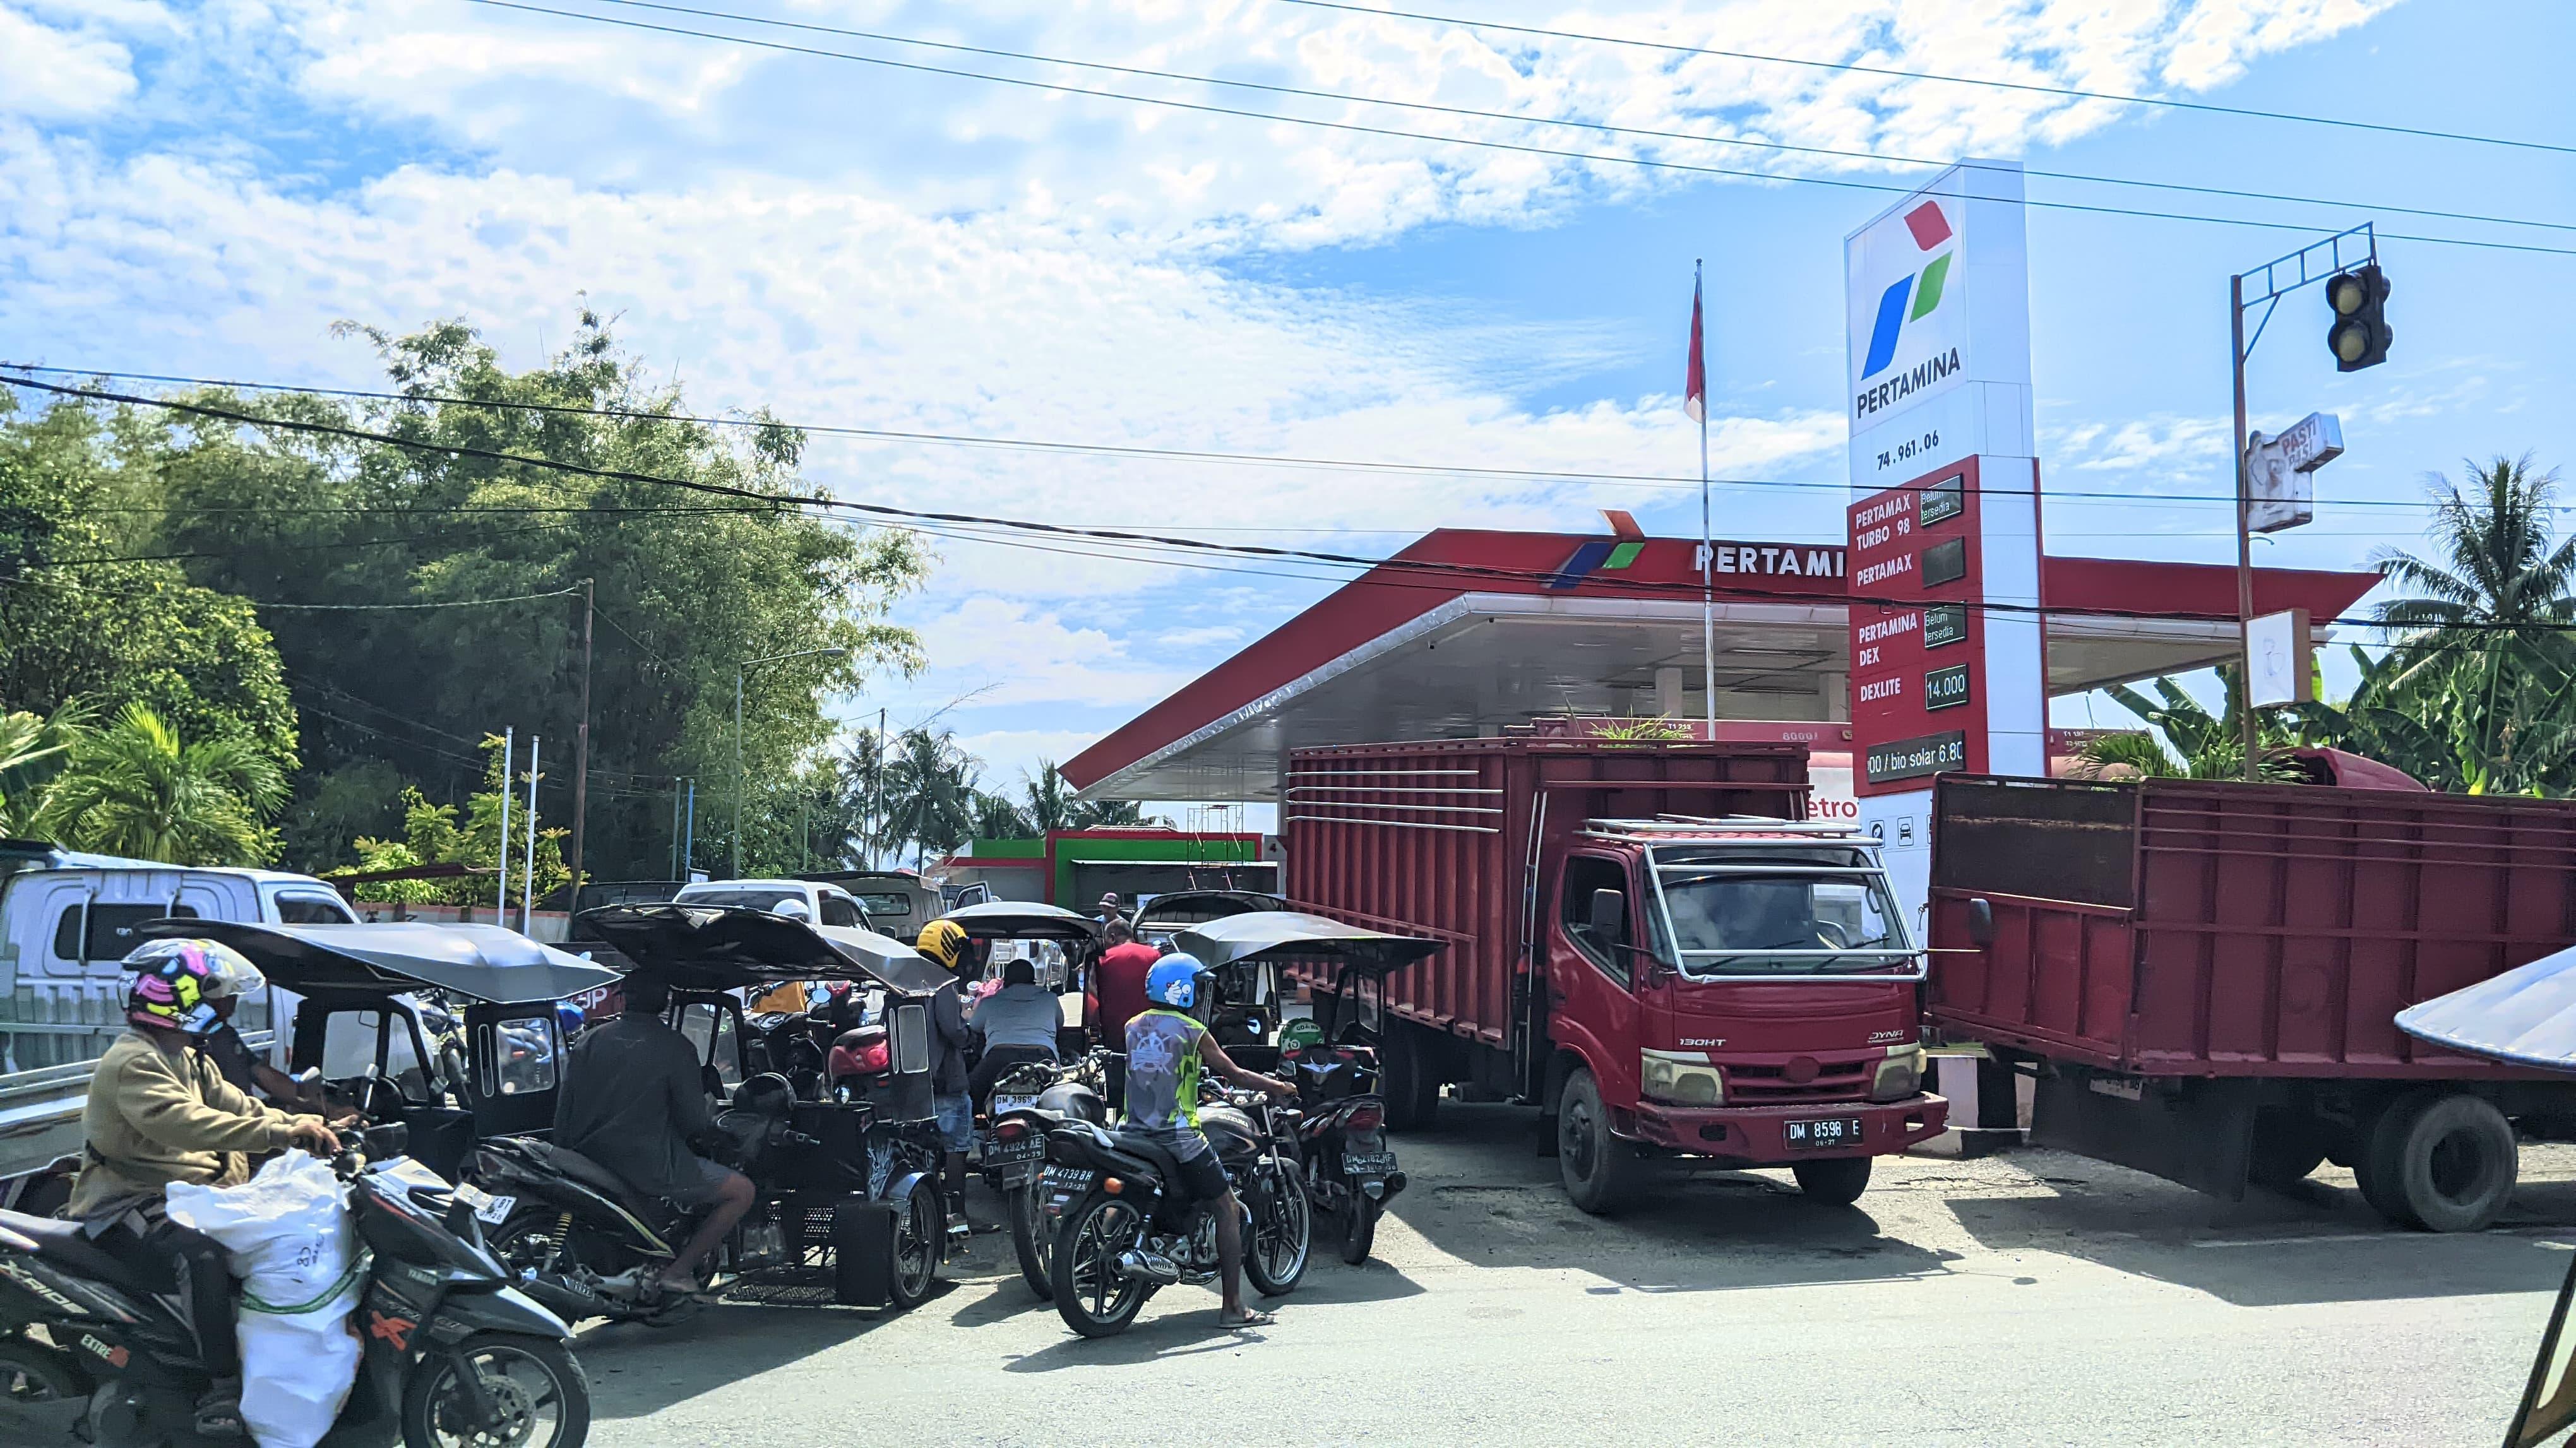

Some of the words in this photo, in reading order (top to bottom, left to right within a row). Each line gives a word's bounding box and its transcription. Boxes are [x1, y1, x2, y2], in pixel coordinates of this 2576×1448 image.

[1857, 347, 1960, 419] PERTAMINA
[2282, 418, 2317, 456] PASTI
[1856, 494, 1911, 529] PERTAMAX
[1921, 502, 1950, 521] tersedia
[1856, 525, 1890, 551] TURBO
[1897, 518, 1910, 536] 98
[1695, 545, 1848, 577] PERTAMI
[1857, 553, 1912, 587] PERTAMAX
[1859, 613, 1917, 644] PERTAMINA
[1925, 613, 1948, 626] Belum
[1859, 646, 1880, 667] DEX
[1861, 677, 1900, 702] DEXLITE
[1927, 674, 1965, 699] 14.000
[1868, 756, 1881, 774] 00
[1891, 752, 1907, 770] bio
[1910, 747, 1936, 767] solar
[1809, 797, 1857, 818] etro
[1679, 1038, 1727, 1047] 130HT
[1868, 1030, 1904, 1040] DYNA
[997, 1095, 1008, 1104] DM
[1218, 1113, 1249, 1129] SUZUKI
[1790, 1124, 1805, 1139] DM
[1814, 1121, 1842, 1137] 8598
[1852, 1120, 1859, 1135] E
[1044, 1166, 1057, 1176] DM
